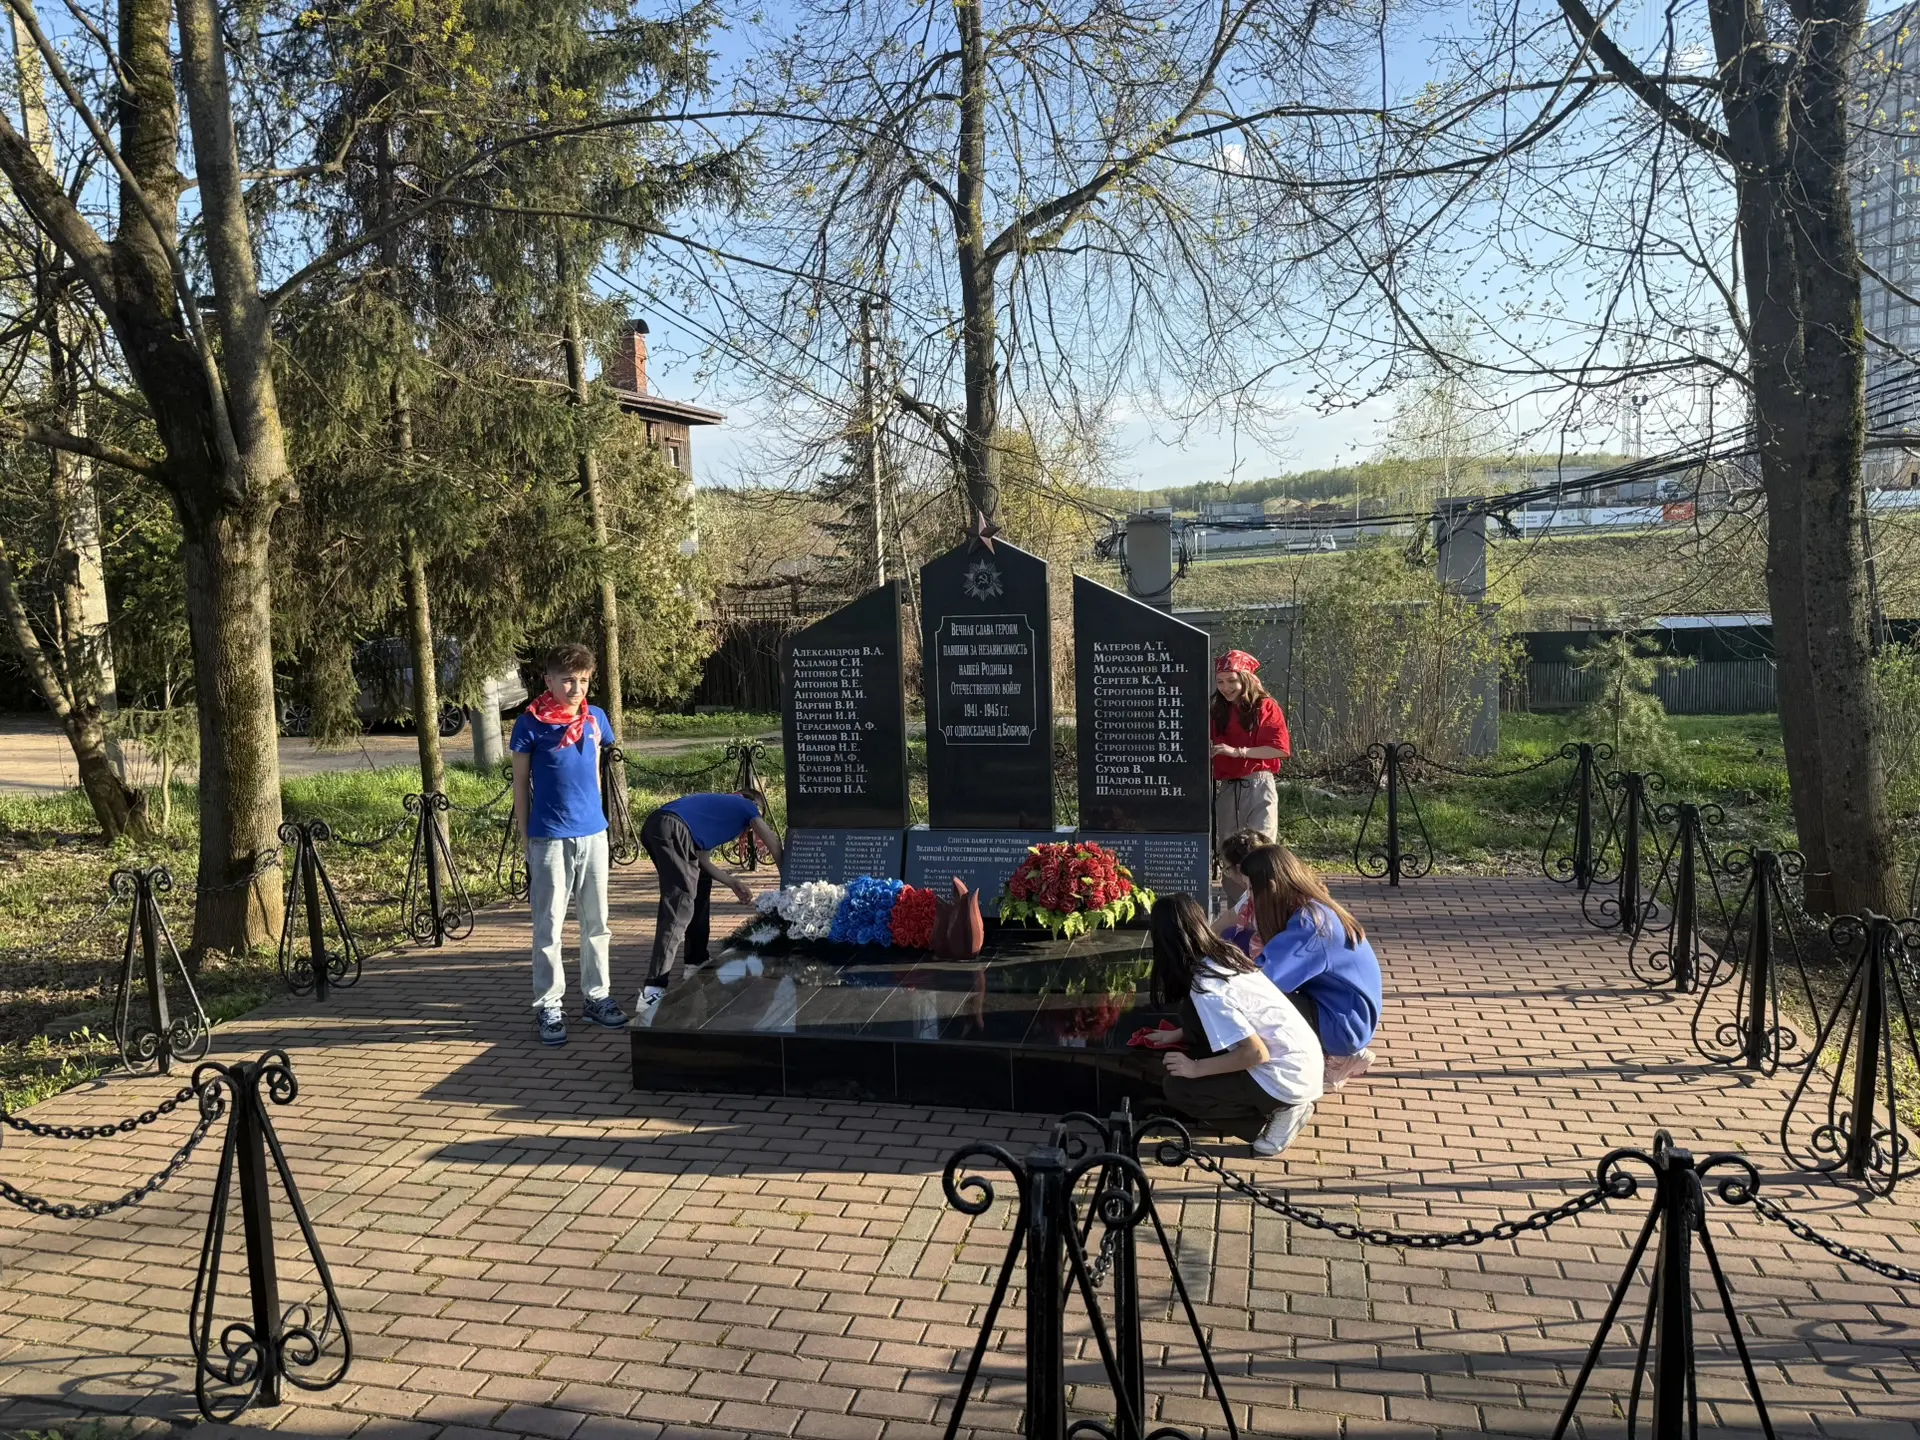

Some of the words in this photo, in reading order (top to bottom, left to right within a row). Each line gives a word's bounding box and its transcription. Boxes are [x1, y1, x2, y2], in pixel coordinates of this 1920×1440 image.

[951, 623, 974, 636] ВЕЧНАЯ
[975, 624, 994, 635] СЛАВА
[995, 623, 1018, 635] ГЕРОЯМ
[943, 645, 969, 656] ПАВШИМ
[970, 645, 978, 655] ЗА
[978, 644, 1028, 655] НЕЗАВИСИМОСТЬ
[1093, 642, 1141, 651] КАТЕРОВ
[1143, 641, 1167, 651] А.Т.
[792, 648, 860, 657] АЛЕКСАНДРОВ
[862, 647, 884, 655] В.А.
[1093, 653, 1144, 663] МОРОЗОВ
[1147, 652, 1174, 662] В.М.
[793, 659, 838, 667] АХЛАМОВ
[840, 658, 864, 666] С.И.
[793, 669, 838, 677] АНТОНОВ
[840, 669, 863, 677] С.И.
[958, 662, 980, 675] НАШЕЙ
[981, 662, 1007, 676] РОДИНЫ
[1009, 664, 1013, 675] В
[1093, 664, 1158, 674] МАРАКАНОВ
[1161, 664, 1188, 673] И.Н.
[794, 680, 838, 688] АНТОНОВ
[841, 679, 862, 688] В.Е.
[1093, 675, 1139, 685] СЕРГЕЕВ
[1142, 675, 1166, 684] К.А.
[951, 681, 1000, 695] ОТЕЧЕСТВЕННУЮ
[1002, 681, 1021, 695] ВОЙНУ
[1093, 687, 1154, 696] СТРОГОНОВ
[1158, 686, 1183, 696] В.Н.
[794, 690, 839, 699] АНТОНОВ
[841, 690, 867, 699] М.И.
[795, 701, 832, 710] ВАРГИН
[835, 701, 857, 709] В.И.
[1094, 698, 1154, 707] СТРОГОНОВ
[1158, 698, 1184, 707] Н.Н.
[964, 704, 978, 717] 1941
[984, 703, 999, 717] 1945
[1000, 705, 1010, 717] Г.Г.
[1094, 709, 1155, 718] СТРОГОНОВ
[1157, 709, 1183, 718] А.Н.
[796, 712, 832, 720] ВАРГИН
[835, 711, 859, 719] И.И.
[796, 722, 851, 731] ГЕРАСИМОВ
[854, 722, 877, 731] А.Ф.
[1094, 720, 1155, 729] СТРОГОНОВ
[1158, 720, 1183, 729] В.Н.
[945, 725, 954, 736] ОТ
[955, 725, 996, 738] ОДНОСЕЛЬЧАН
[1095, 731, 1155, 740] СТРОГОНОВ
[1158, 731, 1183, 740] А.И.
[797, 733, 838, 741] ЕФИМОВ
[797, 743, 836, 752] ИВАНОВ
[839, 743, 861, 751] Н.Е.
[1095, 742, 1155, 752] СТРОГОНОВ
[1158, 743, 1183, 751] В.И.
[798, 754, 831, 762] ИОНОВ
[834, 753, 859, 762] М.Ф.
[1095, 753, 1155, 763] СТРОГОНОВ
[1158, 754, 1187, 763] Ю.А.
[798, 764, 841, 772] КРАЕНОВ
[844, 764, 868, 772] Н.И.
[1095, 764, 1130, 774] СУХОВ
[1133, 765, 1144, 774] В.
[799, 774, 842, 783] КРАЕНОВ
[845, 775, 867, 783] В.П.
[1096, 776, 1141, 785] ШАДРОВ
[1144, 776, 1170, 785] П.П.
[799, 785, 841, 793] КАТЕРОВ
[844, 785, 866, 793] Н.А.
[1096, 787, 1157, 796] ШАНДОРИН
[1161, 787, 1186, 796] В.И.
[947, 836, 970, 844] СПИСОК
[943, 845, 988, 853] ОТЕЧЕСТВЕННОЙ
